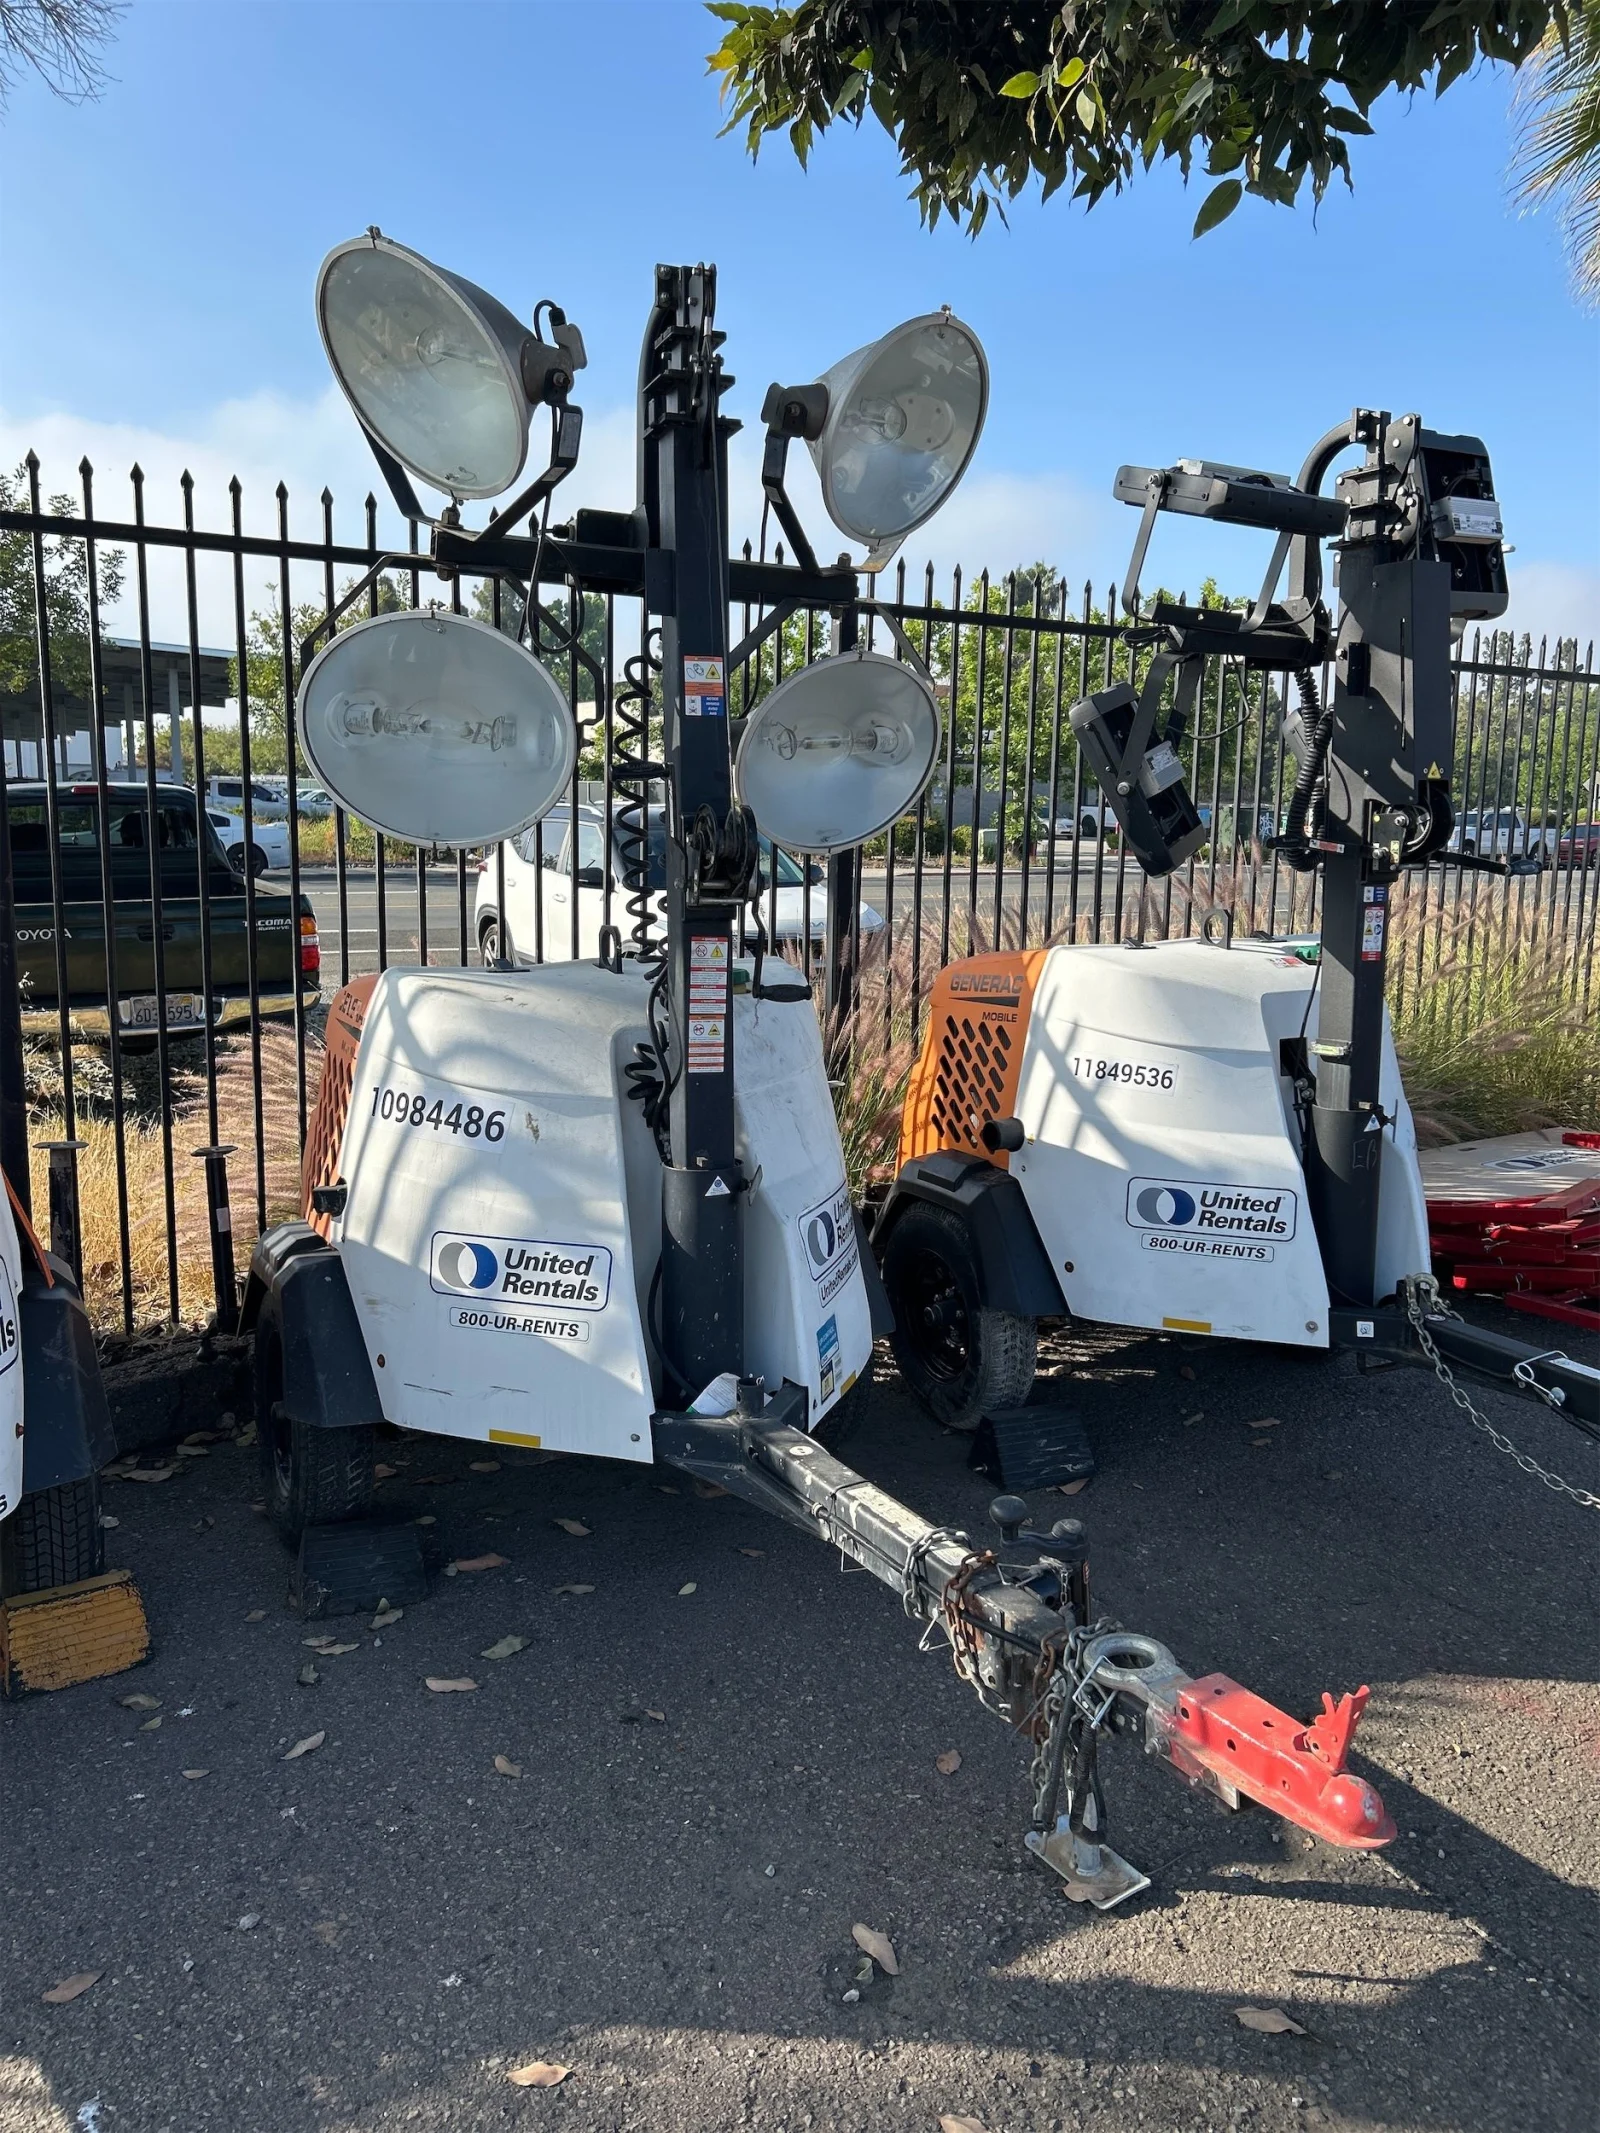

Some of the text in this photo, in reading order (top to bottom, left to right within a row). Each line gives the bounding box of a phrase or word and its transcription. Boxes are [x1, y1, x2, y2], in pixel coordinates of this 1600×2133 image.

[242, 918, 292, 928] TCOMA
[950, 974, 1024, 994] GENERAC
[135, 1004, 192, 1023] 6D3595
[982, 1011, 1018, 1023] MOBILE
[1073, 1057, 1174, 1090] 11849536
[371, 1086, 507, 1143] 10984486
[1200, 1190, 1282, 1214] United
[1197, 1209, 1287, 1234] Rentals
[1149, 1237, 1267, 1260] 800-UR-RENTS
[504, 1247, 595, 1277] United
[501, 1271, 599, 1302] Rentals
[458, 1311, 580, 1337] 800-UR-RENTS
